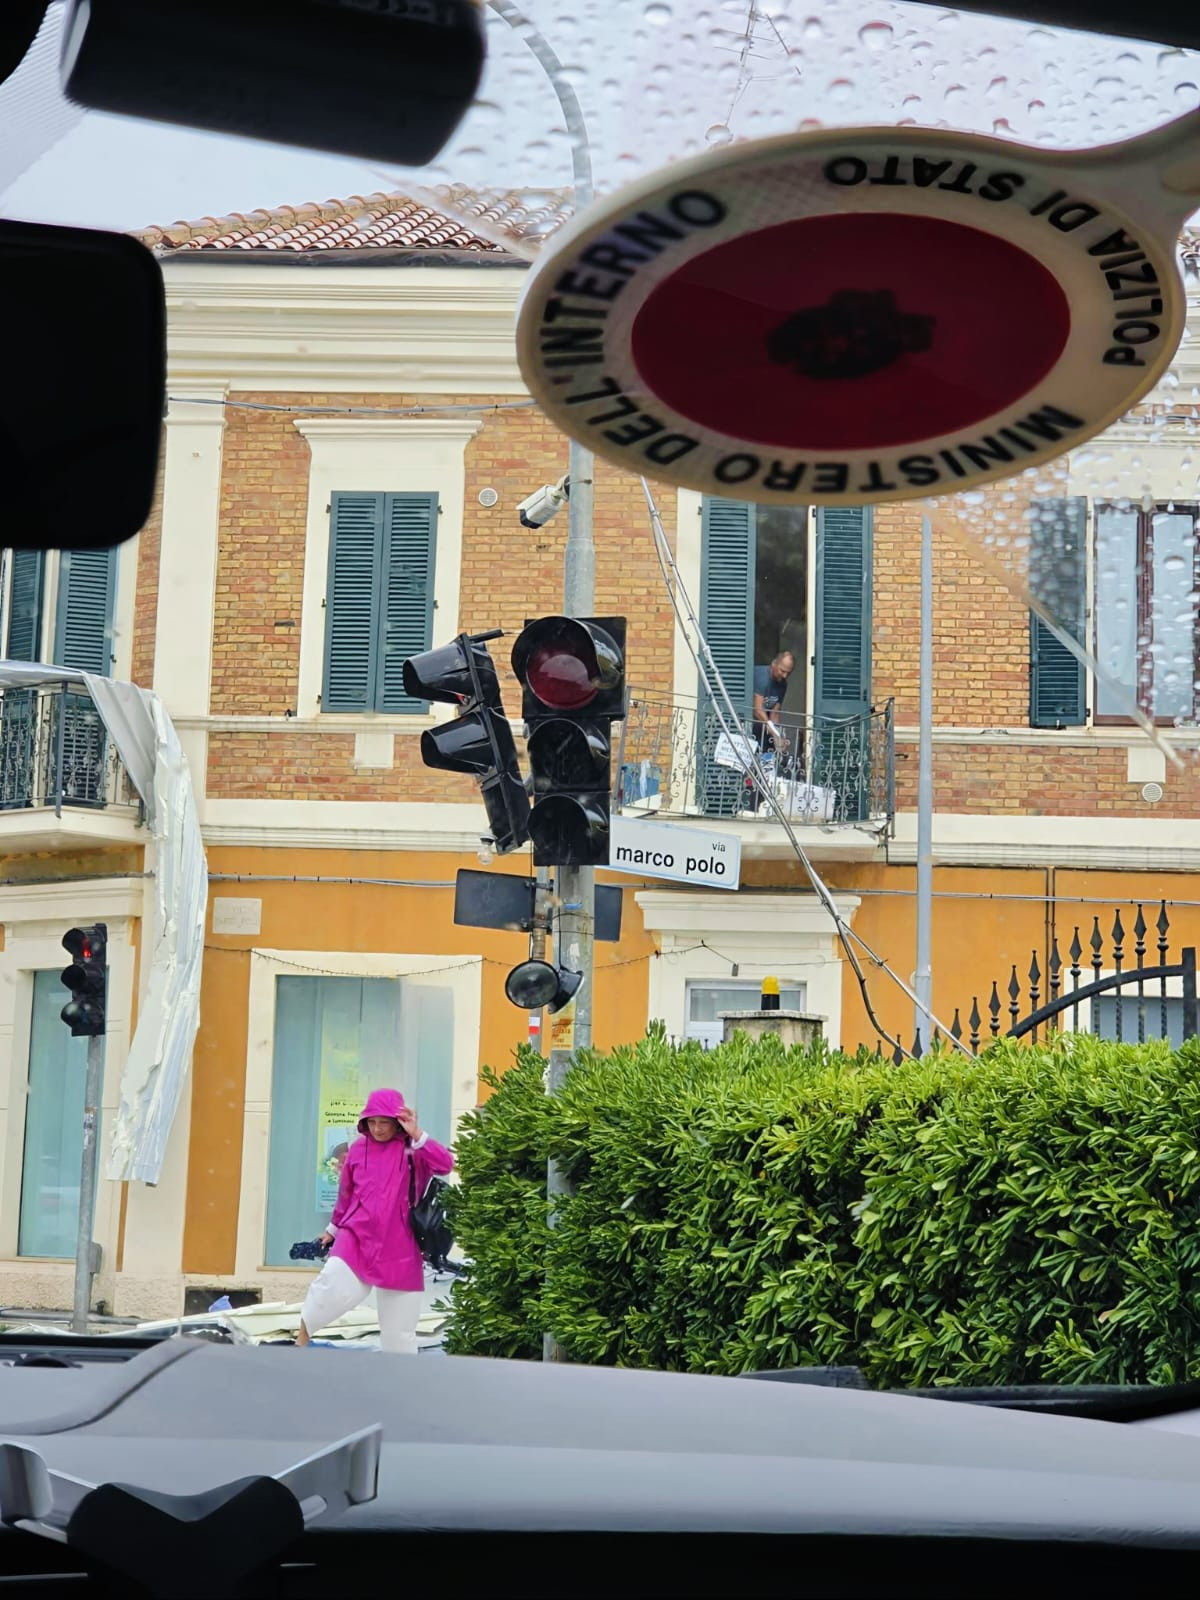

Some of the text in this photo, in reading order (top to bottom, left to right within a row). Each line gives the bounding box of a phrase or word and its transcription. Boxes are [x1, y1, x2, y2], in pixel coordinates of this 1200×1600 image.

[824, 156, 1163, 366] POLIZIA DI STATO
[713, 404, 1085, 492] MINISTERO
[616, 847, 726, 875] marco polo
[712, 842, 726, 852] via
